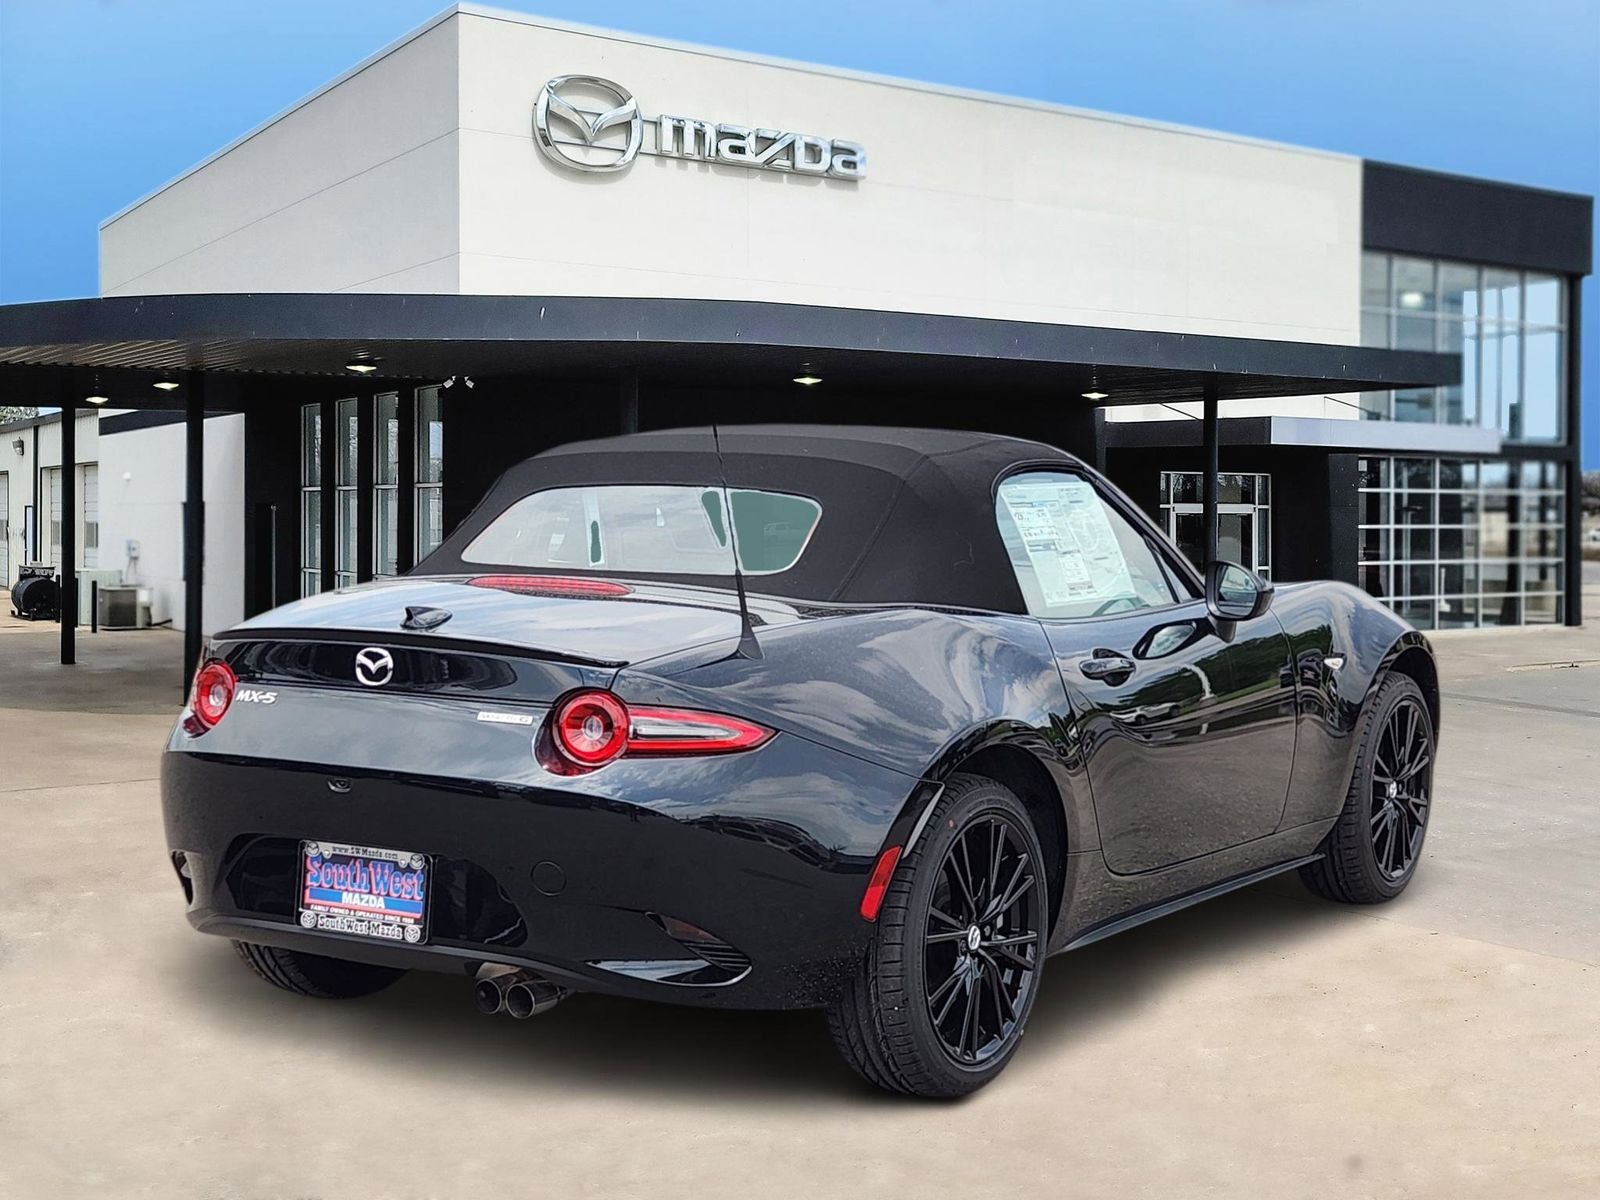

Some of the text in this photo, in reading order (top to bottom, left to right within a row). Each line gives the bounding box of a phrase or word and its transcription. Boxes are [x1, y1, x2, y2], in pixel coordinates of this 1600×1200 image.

[236, 689, 278, 704] MX-5
[341, 892, 386, 909] MAZDA
[310, 904, 329, 912] FAMILY
[329, 907, 350, 915] OWNED
[355, 910, 384, 919] OPERATED
[384, 914, 401, 922] SINCE
[317, 914, 404, 939] SouthWest Mazda
